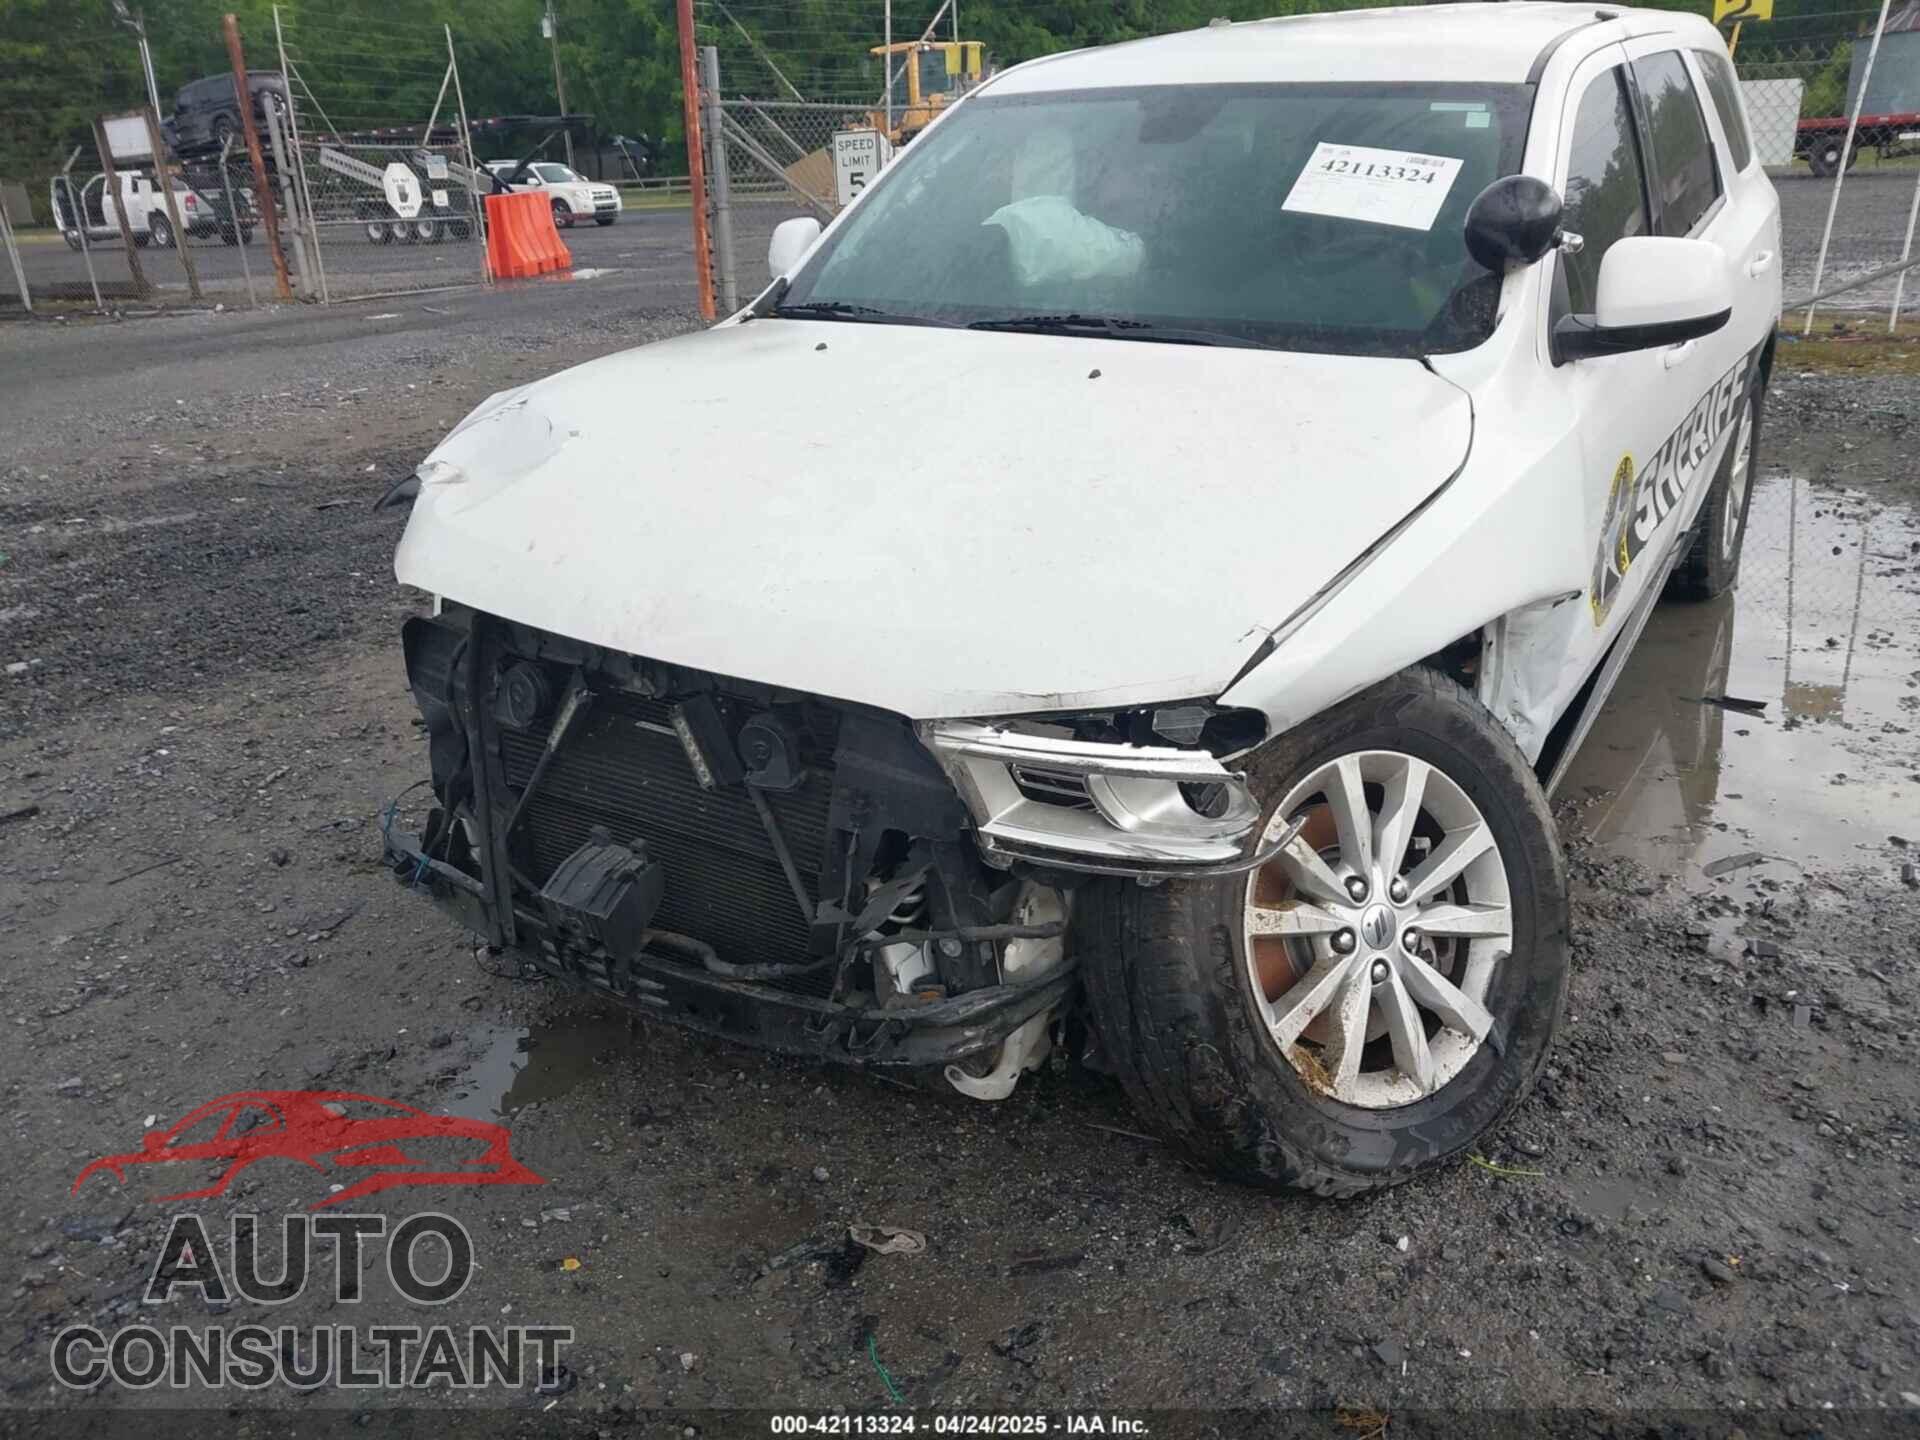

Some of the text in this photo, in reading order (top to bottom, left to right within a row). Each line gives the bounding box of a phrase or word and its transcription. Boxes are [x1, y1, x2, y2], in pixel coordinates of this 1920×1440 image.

[838, 138, 874, 152] SPEED
[842, 155, 870, 168] LIMIT
[1320, 158, 1436, 184] 42113324
[850, 172, 866, 198] 5
[1634, 354, 1749, 542] SHERIFF
